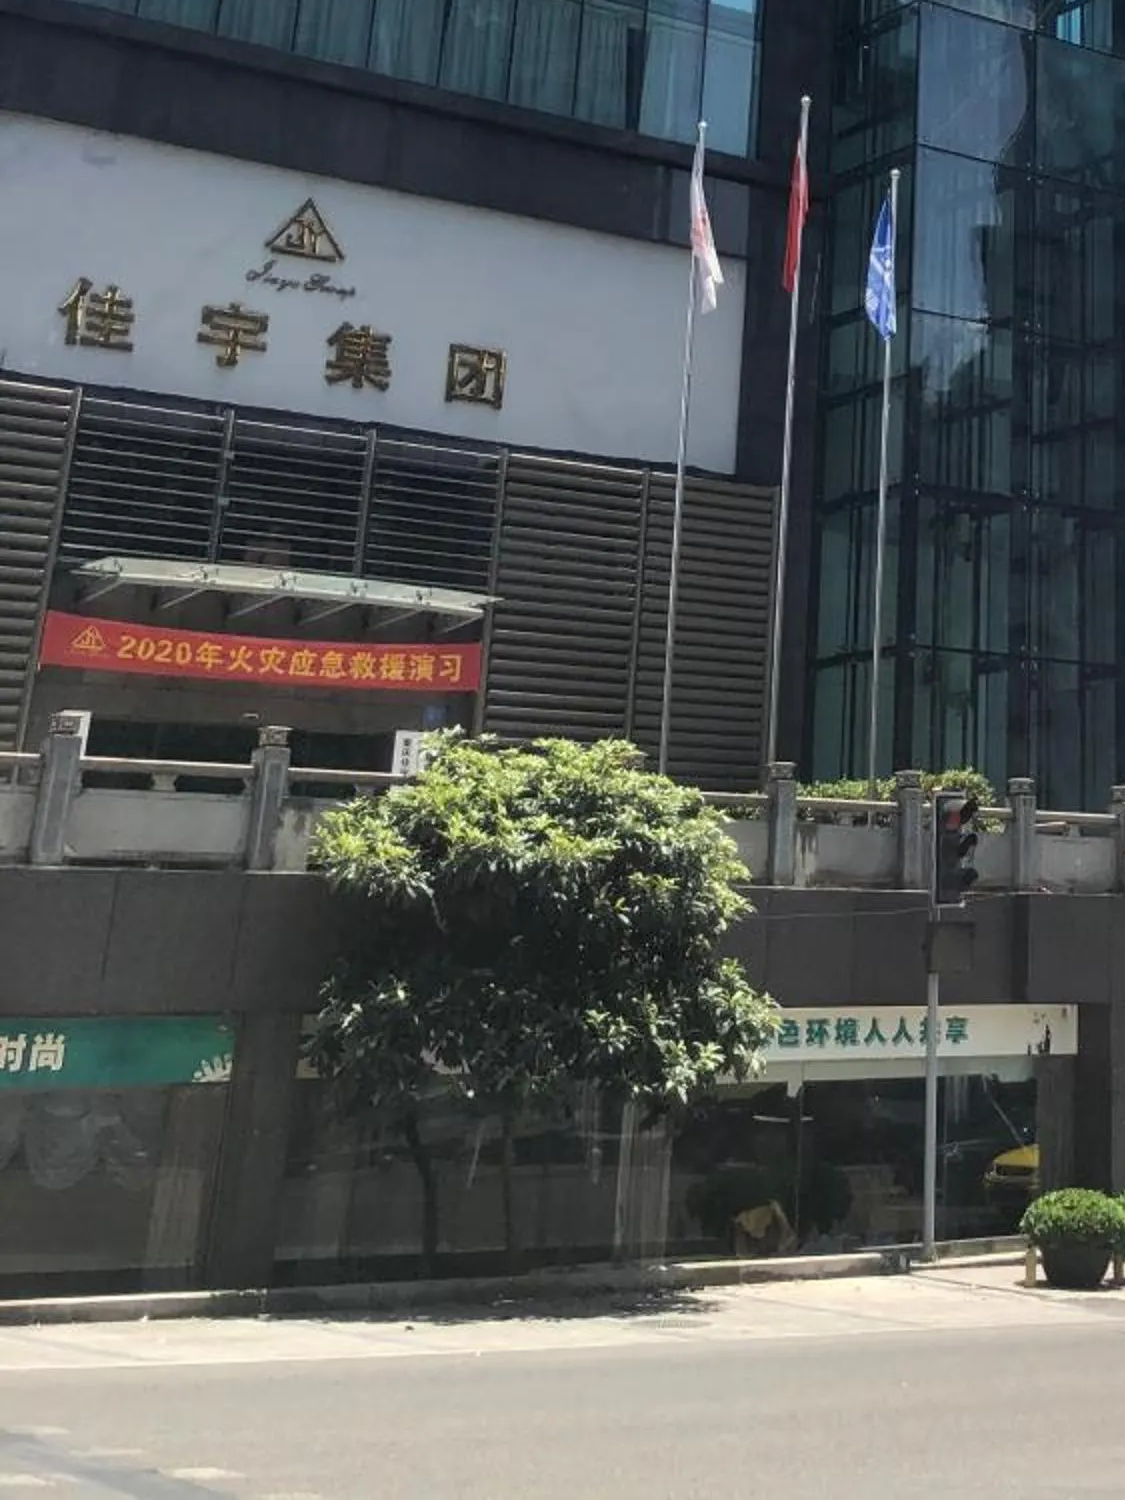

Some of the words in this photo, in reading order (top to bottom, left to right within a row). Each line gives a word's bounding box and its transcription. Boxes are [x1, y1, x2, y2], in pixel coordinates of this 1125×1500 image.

[57, 277, 508, 410] 佳宇集团
[116, 634, 462, 683] 2020年火灾应急救援演习
[761, 1015, 969, 1050] 色环境人人共享
